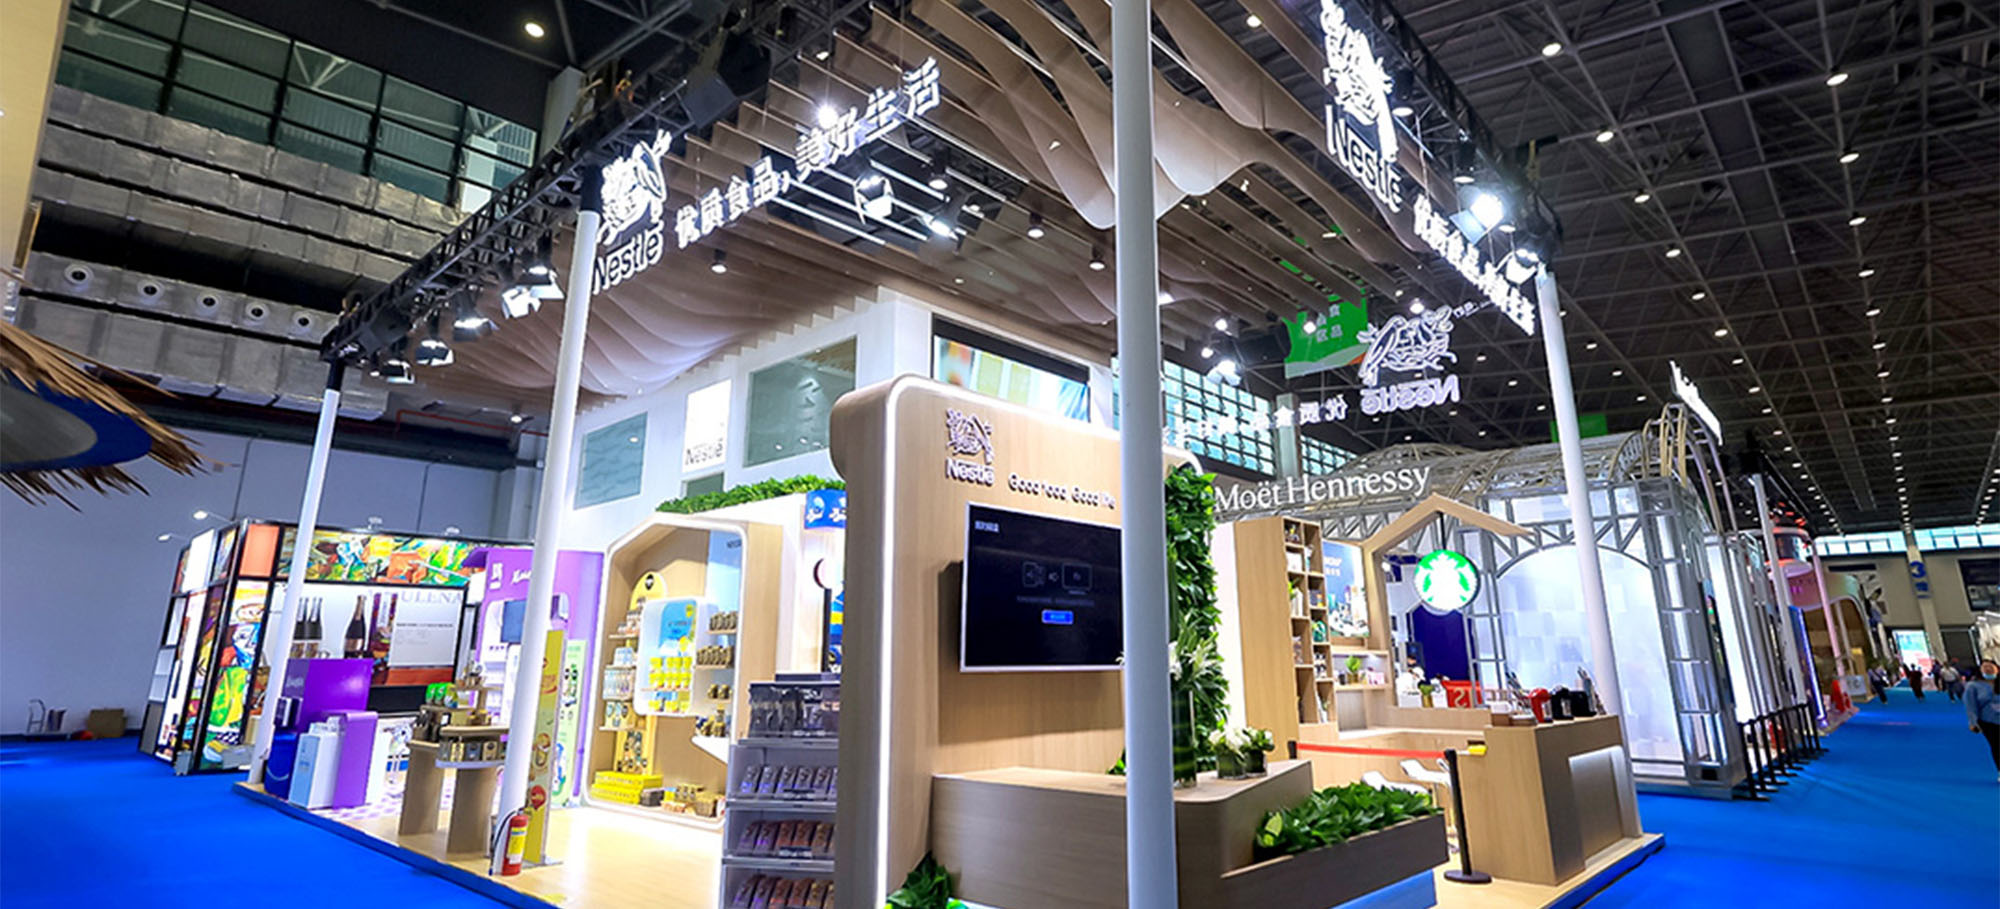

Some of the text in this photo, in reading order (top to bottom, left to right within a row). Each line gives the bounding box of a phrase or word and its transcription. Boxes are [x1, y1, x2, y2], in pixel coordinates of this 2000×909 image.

[1325, 104, 1402, 214] Nestlé
[1214, 466, 1430, 512] Moët Hennessy
